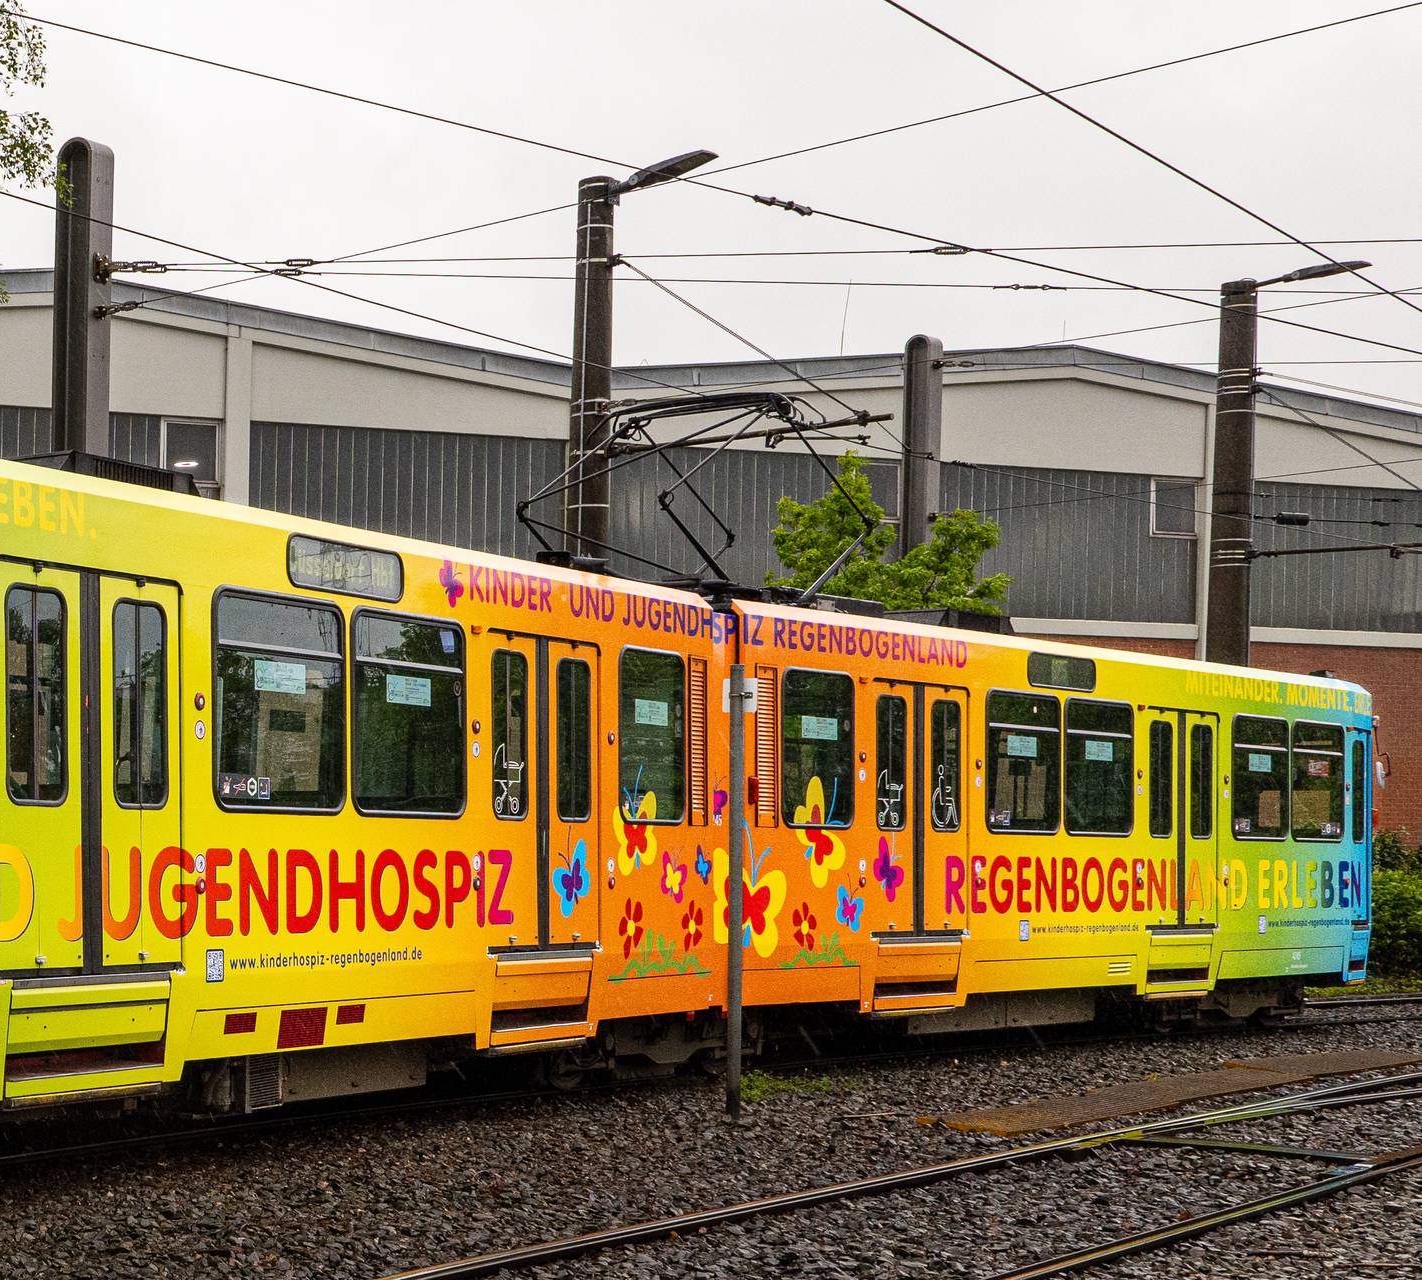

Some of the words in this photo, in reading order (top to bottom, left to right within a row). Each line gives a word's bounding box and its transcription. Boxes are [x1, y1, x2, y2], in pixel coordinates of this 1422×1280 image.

[469, 564, 552, 613] KINDER
[570, 582, 614, 623] UND
[774, 616, 968, 669] REGENBOGENLAND
[1185, 670, 1282, 703] MITEINANDER.
[1286, 684, 1352, 712] MOMENTE.
[57, 846, 514, 942] JUGENDHOSPIZ
[945, 855, 1247, 914] REGENBOGENLAND
[1257, 859, 1362, 910] ERLEBEN
[230, 946, 422, 970] www.kinderhospiz-regenbogenland.de
